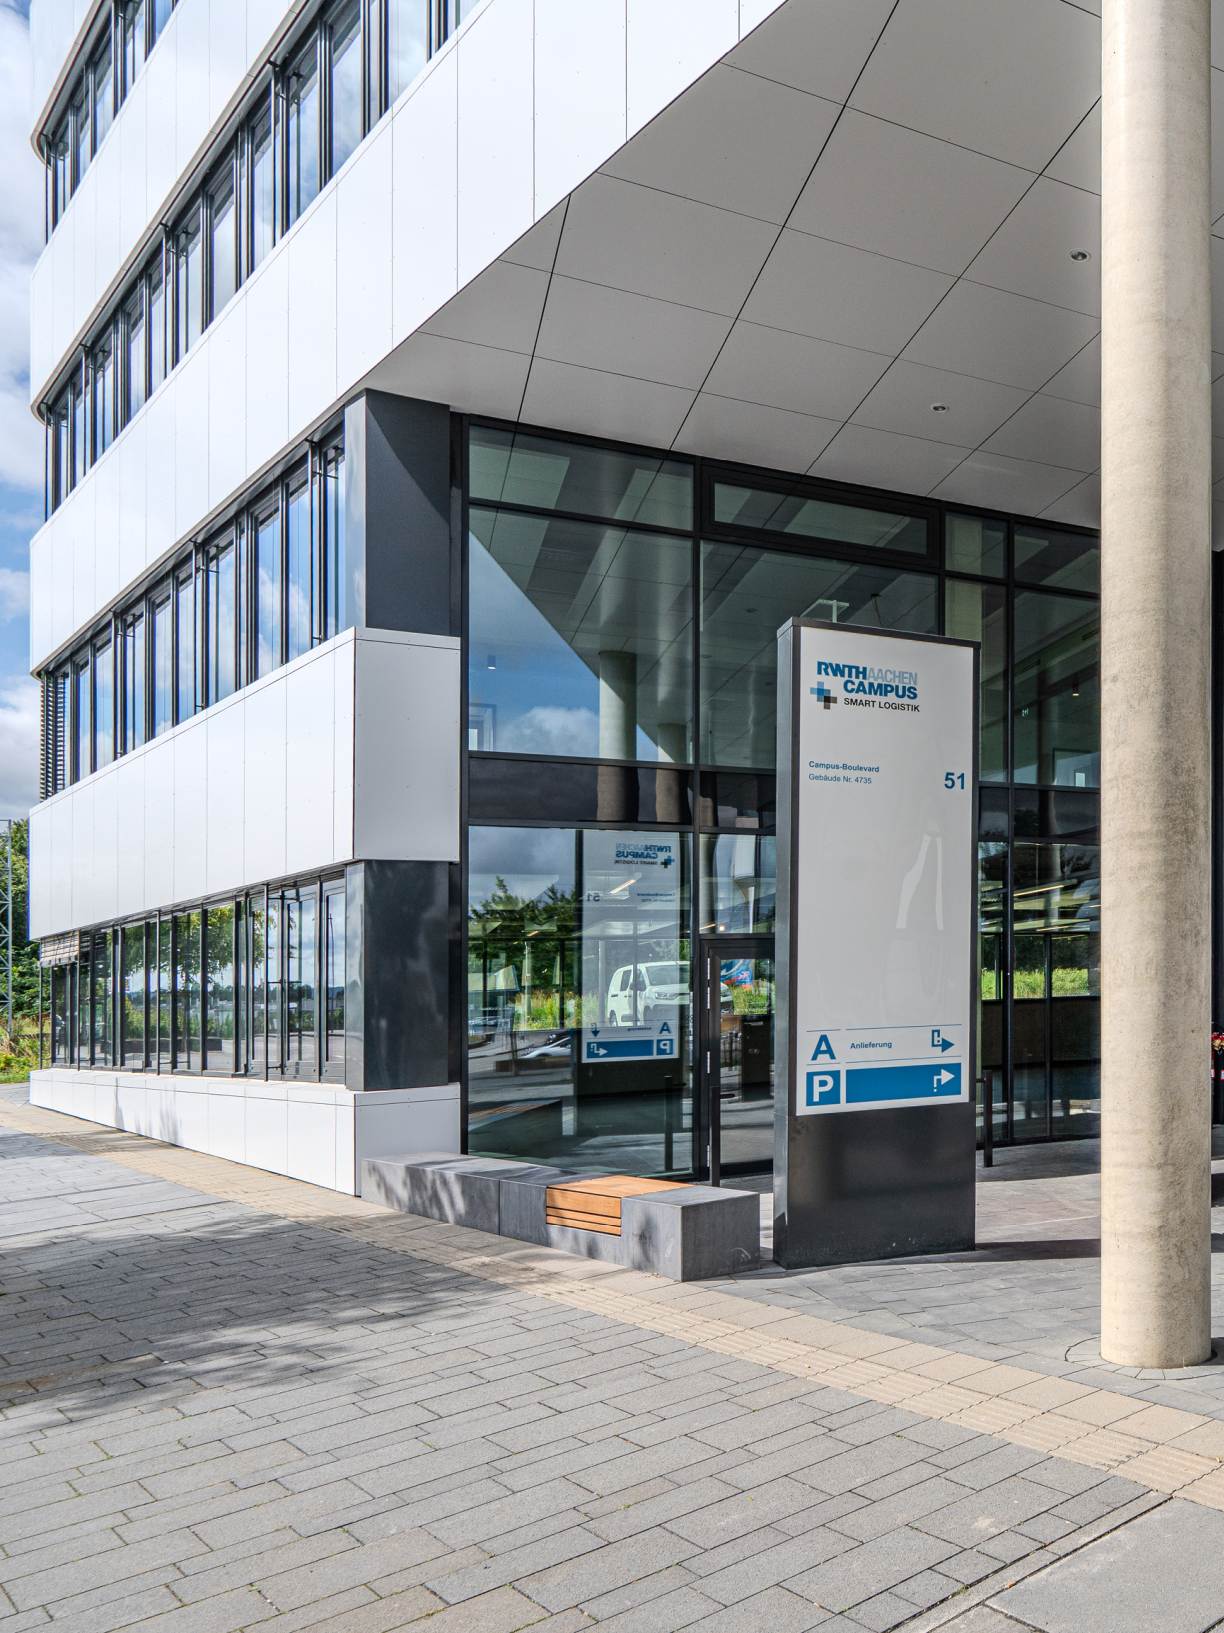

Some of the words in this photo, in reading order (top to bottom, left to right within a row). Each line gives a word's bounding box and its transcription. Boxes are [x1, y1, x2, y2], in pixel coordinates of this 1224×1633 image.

[843, 679, 918, 700] CAMPUS
[843, 697, 877, 708] SMART
[878, 701, 920, 712] LOGISTIK
[809, 760, 880, 773] Campus-Boulevard
[843, 775, 853, 783] Nr.
[854, 776, 872, 785] 4735
[944, 772, 965, 790] 51
[811, 1034, 837, 1061] A
[850, 1040, 892, 1050] Anlieferung
[813, 1075, 834, 1102] P
